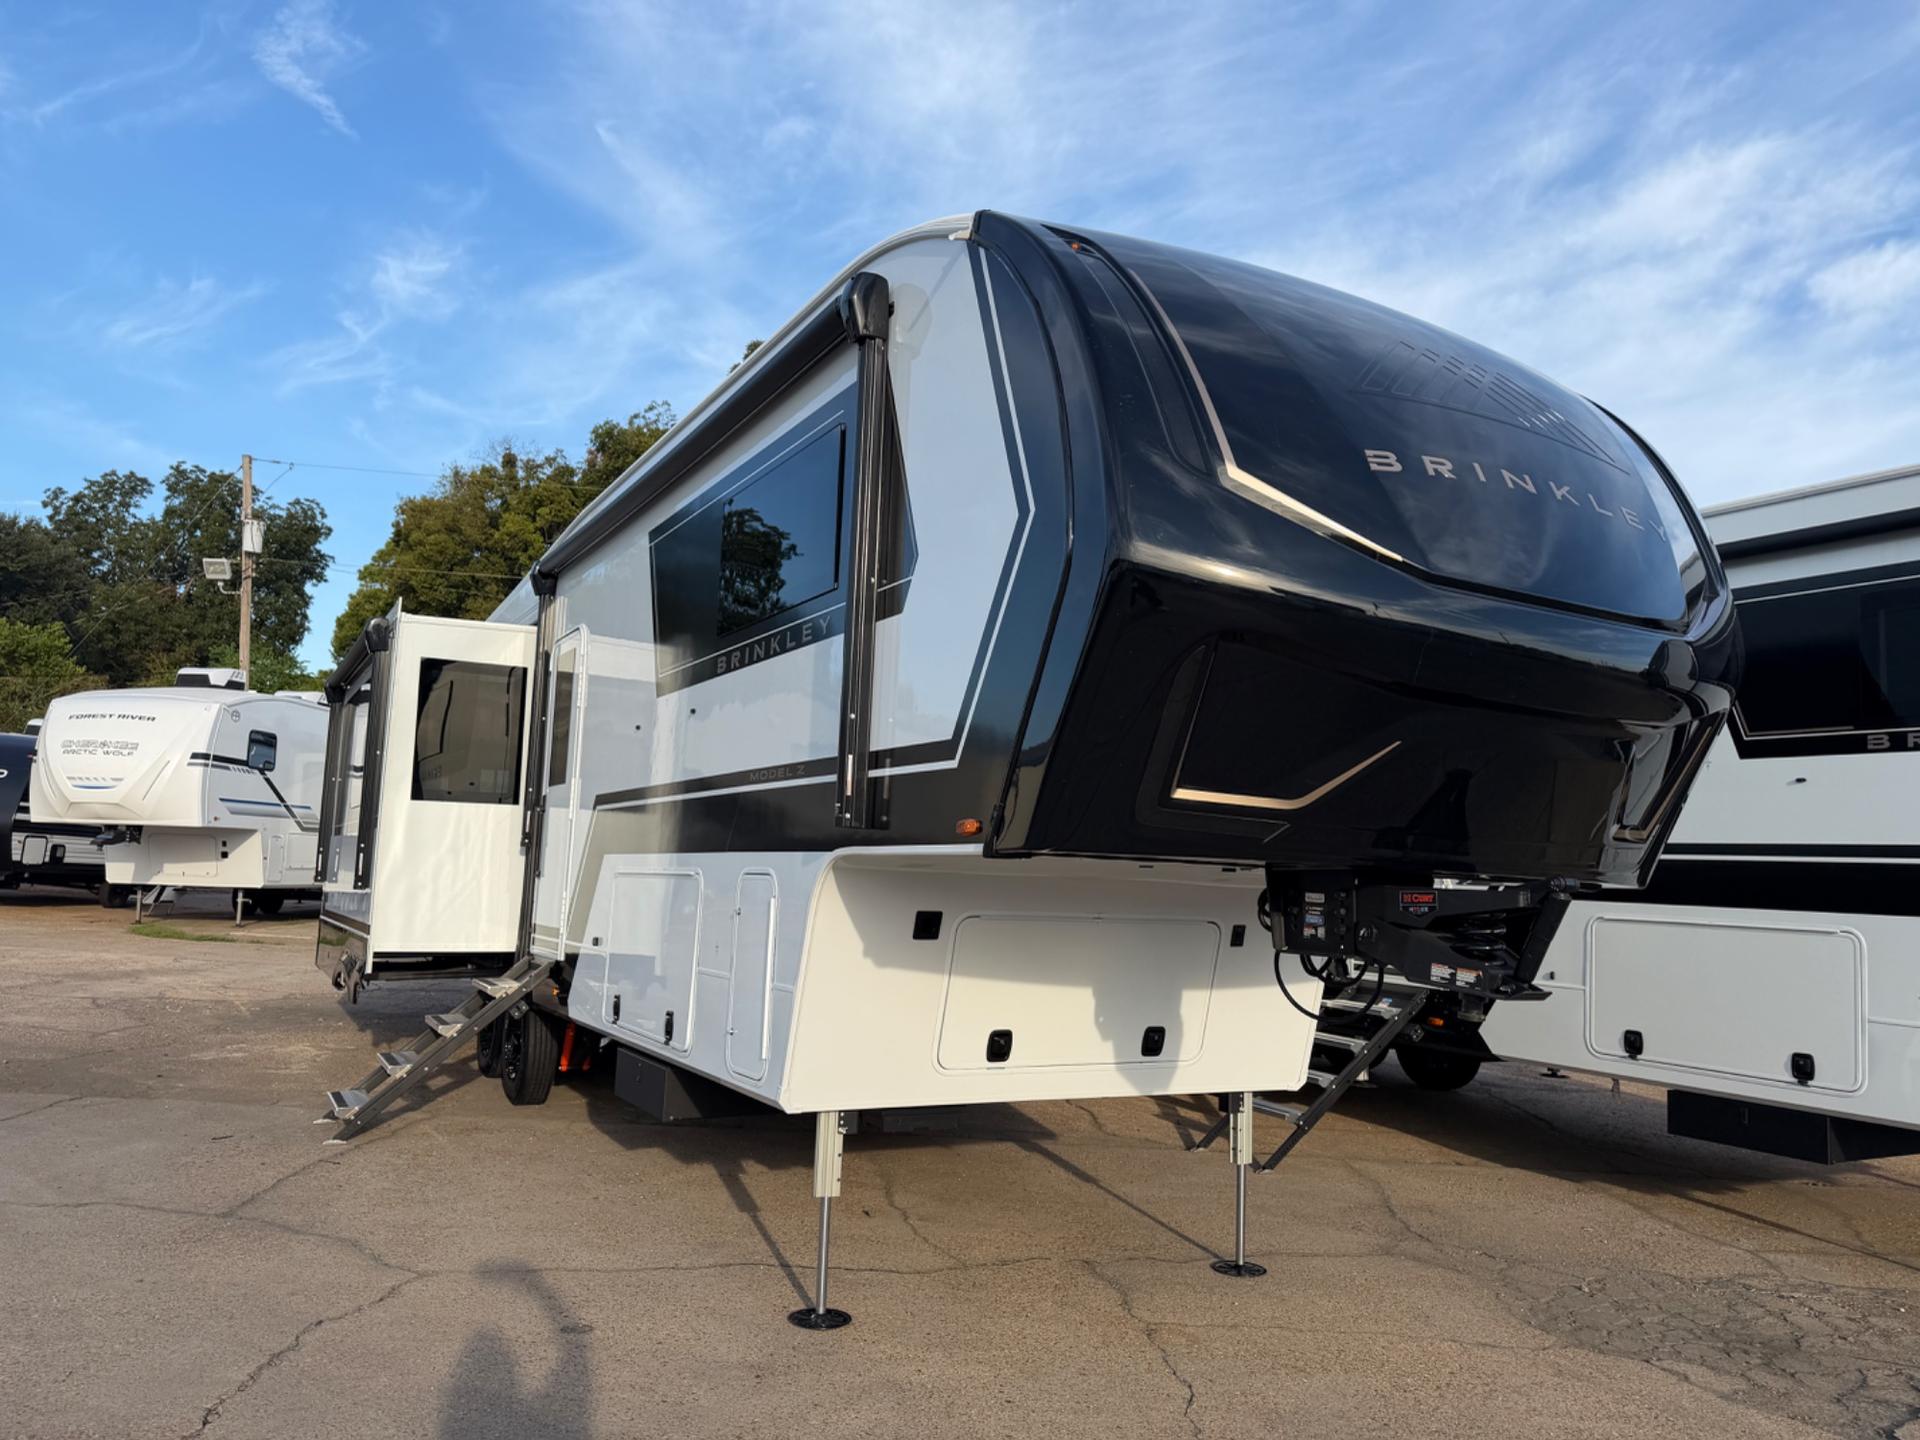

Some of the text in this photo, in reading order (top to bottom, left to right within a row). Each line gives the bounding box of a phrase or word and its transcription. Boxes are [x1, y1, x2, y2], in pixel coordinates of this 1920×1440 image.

[1364, 448, 1667, 542] BRINKLEY
[717, 615, 831, 675] BRINKLEY
[117, 713, 156, 721] RIVER
[750, 767, 793, 781] MODEL
